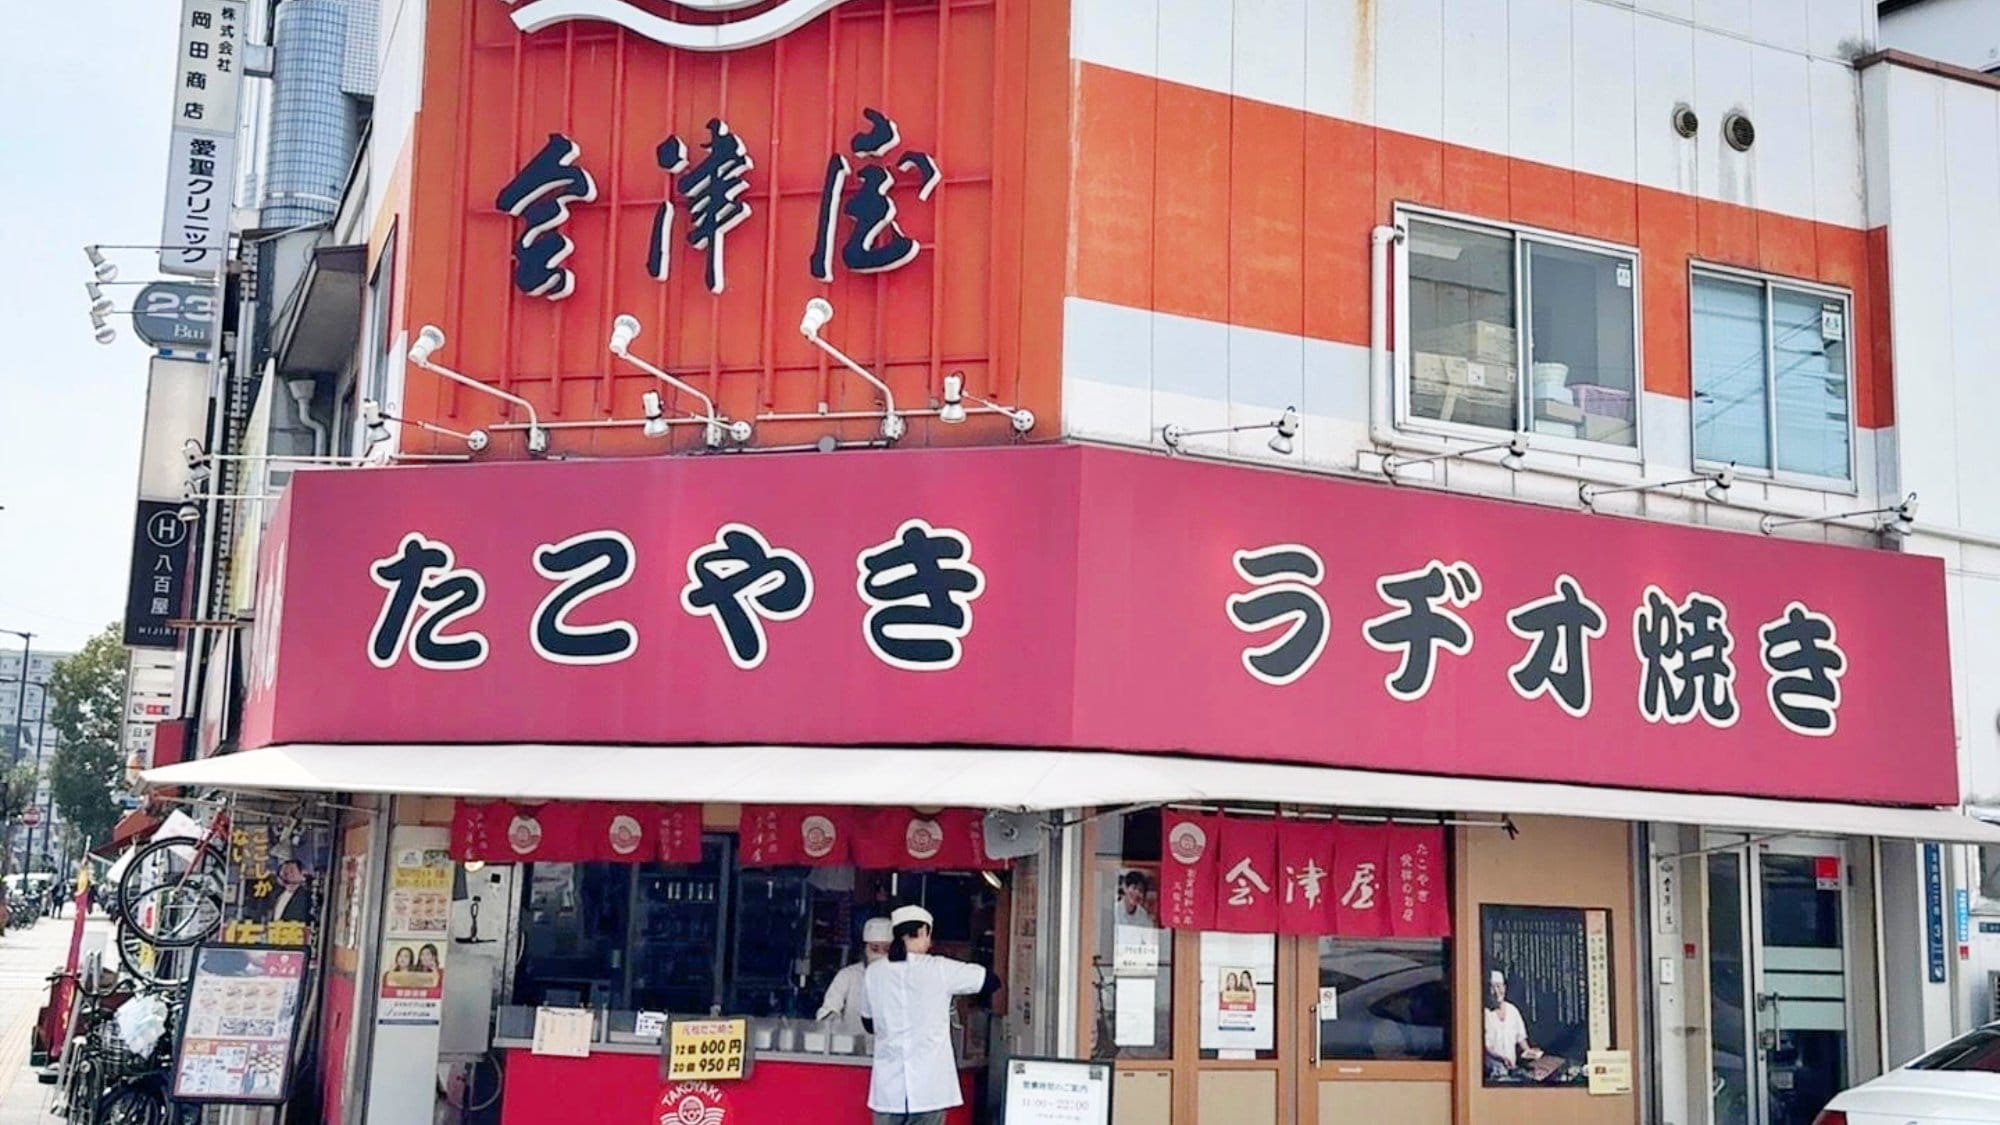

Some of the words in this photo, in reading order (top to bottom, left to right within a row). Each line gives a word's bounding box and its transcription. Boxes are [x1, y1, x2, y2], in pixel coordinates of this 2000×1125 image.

[184, 10, 212, 120] 岡田商店
[217, 6, 236, 73] 株式会社
[181, 138, 217, 263] 愛聖クリニック
[496, 107, 943, 301] 会津屋
[150, 553, 174, 616] 八百屋
[368, 517, 987, 671] たこやき
[1225, 541, 1848, 738] ラヂオ焼き
[253, 827, 273, 898] ここしか
[1225, 857, 1380, 910] 会津屋
[1415, 843, 1430, 903] たこやき
[660, 1080, 723, 1107] TAKOYAKI
